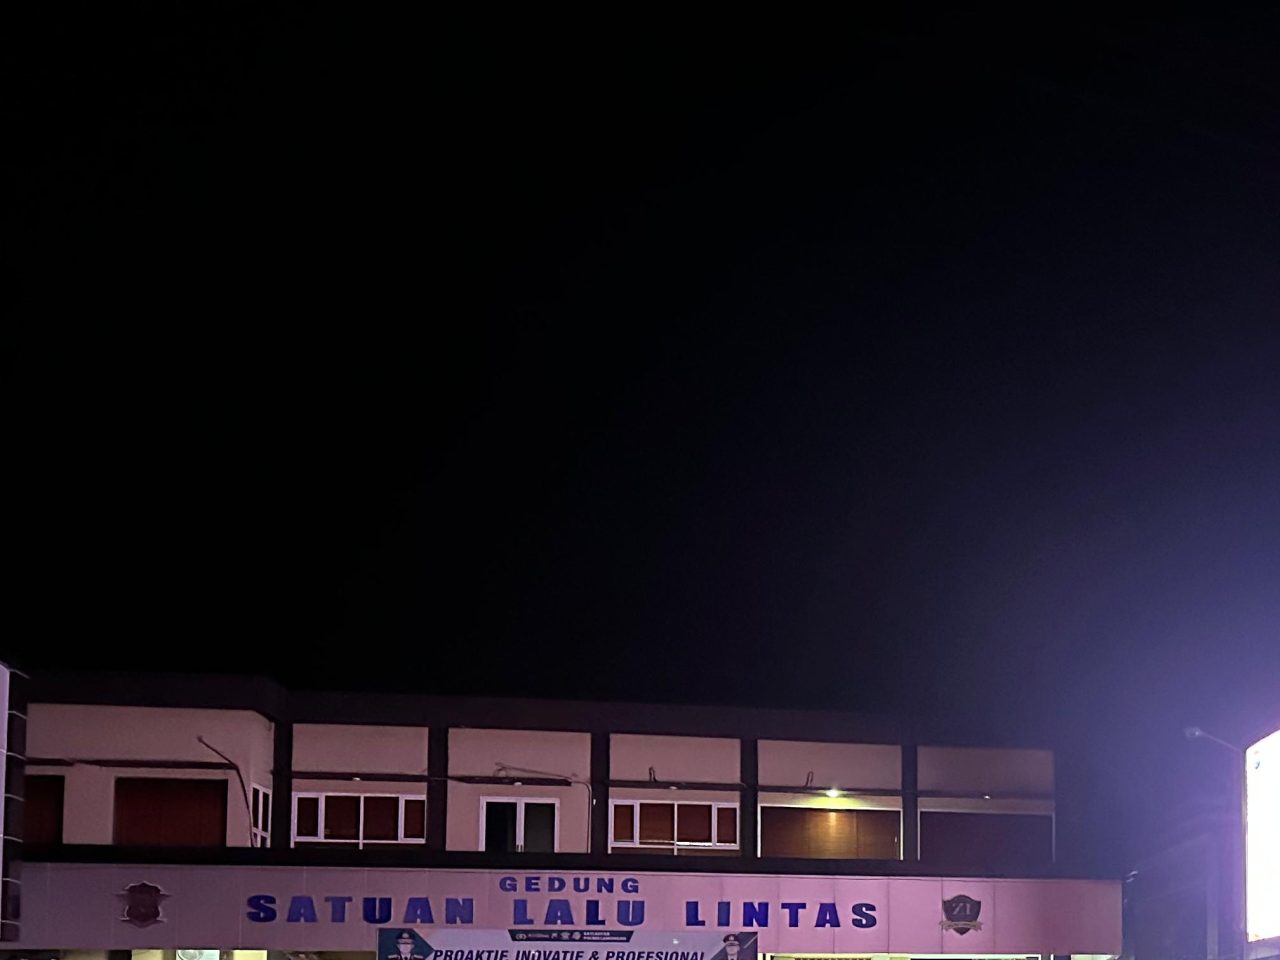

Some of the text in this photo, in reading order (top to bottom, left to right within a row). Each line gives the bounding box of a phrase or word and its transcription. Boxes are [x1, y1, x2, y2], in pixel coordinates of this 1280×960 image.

[500, 876, 639, 894] GEDUNG
[246, 894, 877, 929] SATUAN LALU LINTAS
